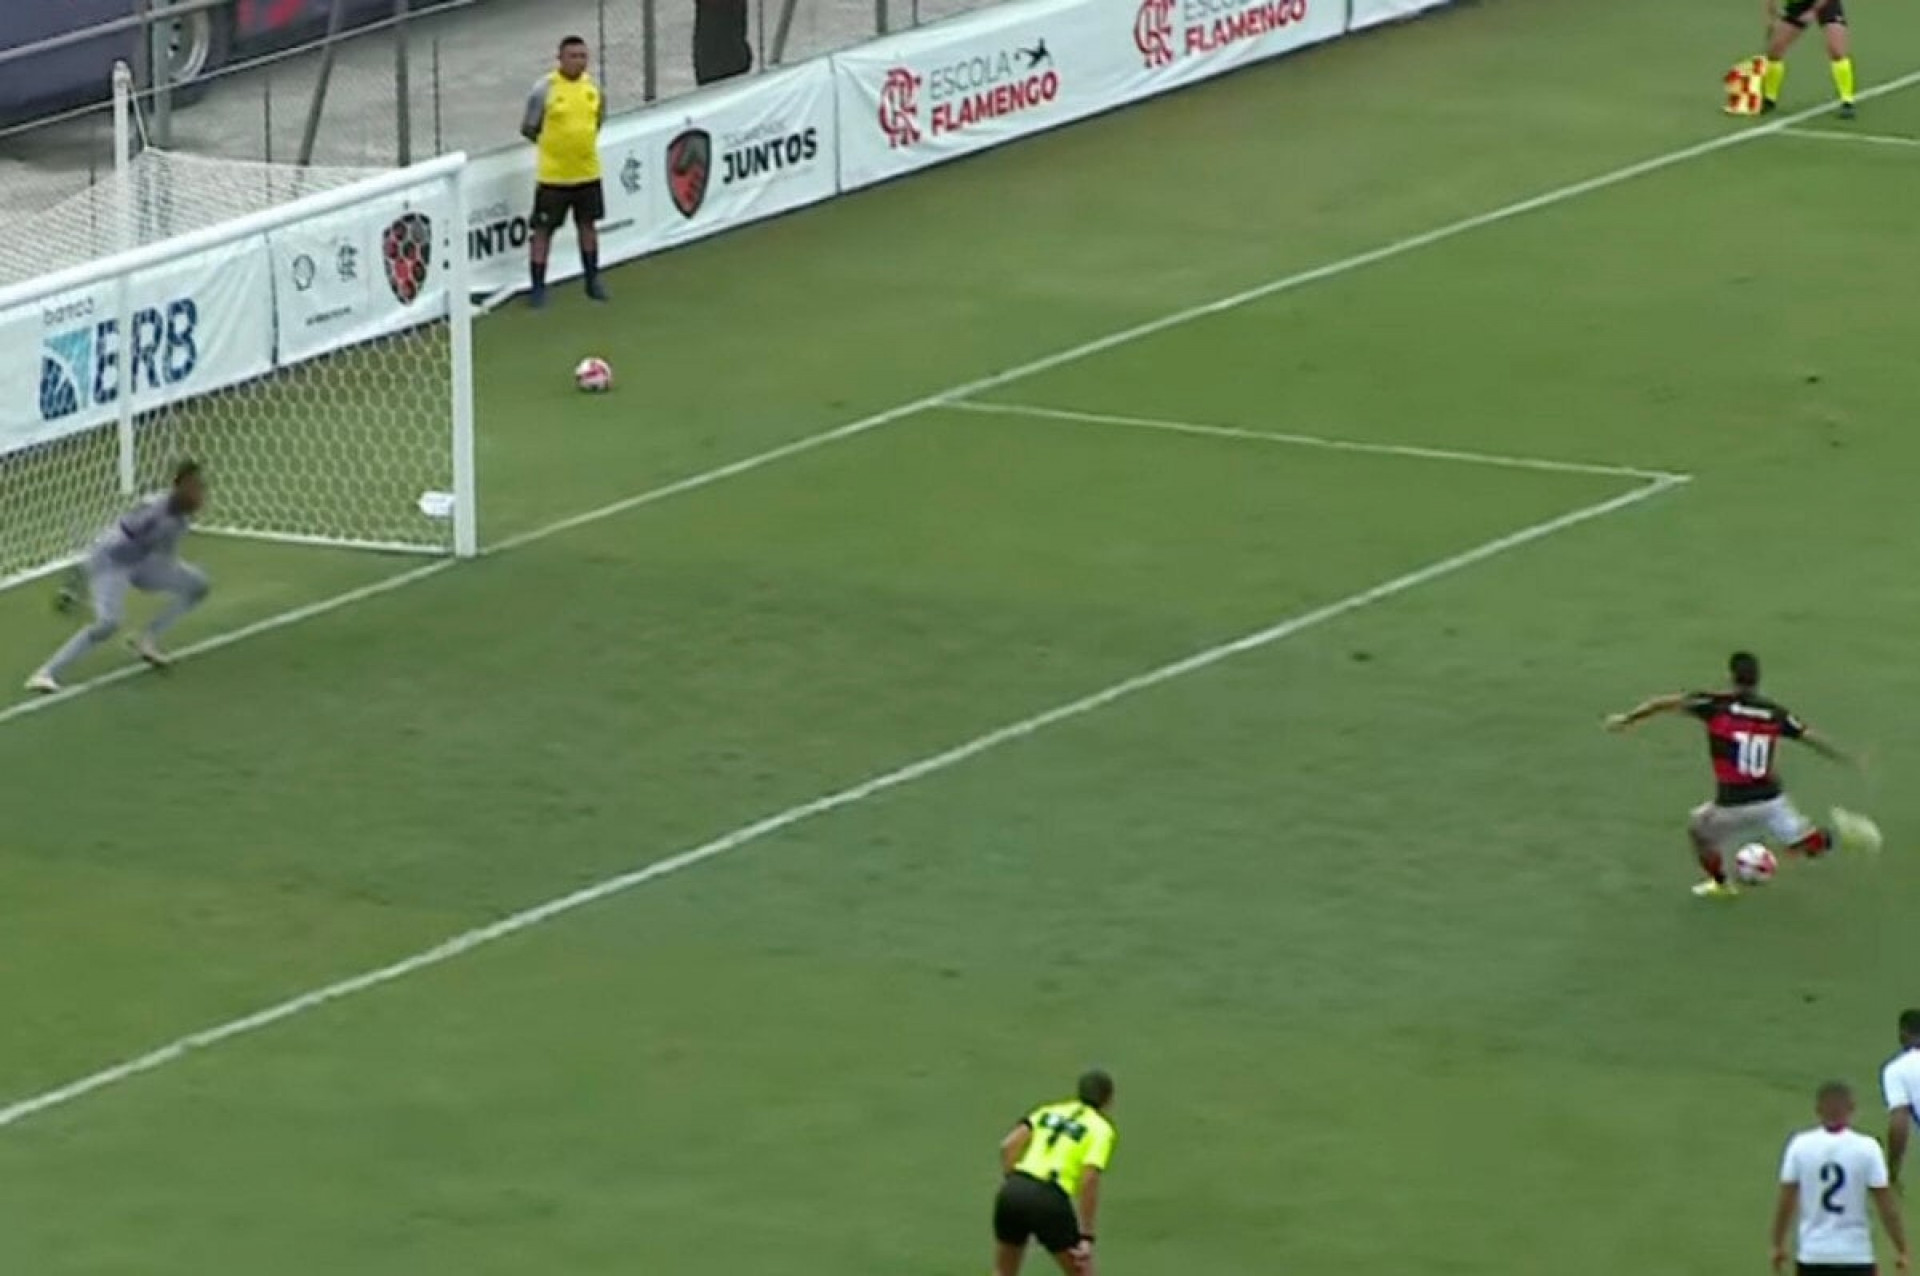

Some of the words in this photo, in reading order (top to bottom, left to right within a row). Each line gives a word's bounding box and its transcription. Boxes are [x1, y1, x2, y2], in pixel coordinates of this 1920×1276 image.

[1185, 0, 1307, 56] FLAMENGO
[930, 51, 1012, 100] ESCOLA
[931, 71, 1058, 135] FLAMENGO
[723, 126, 817, 184] JUNTOS
[1732, 731, 1770, 778] 10
[1820, 1163, 1846, 1214] 2
